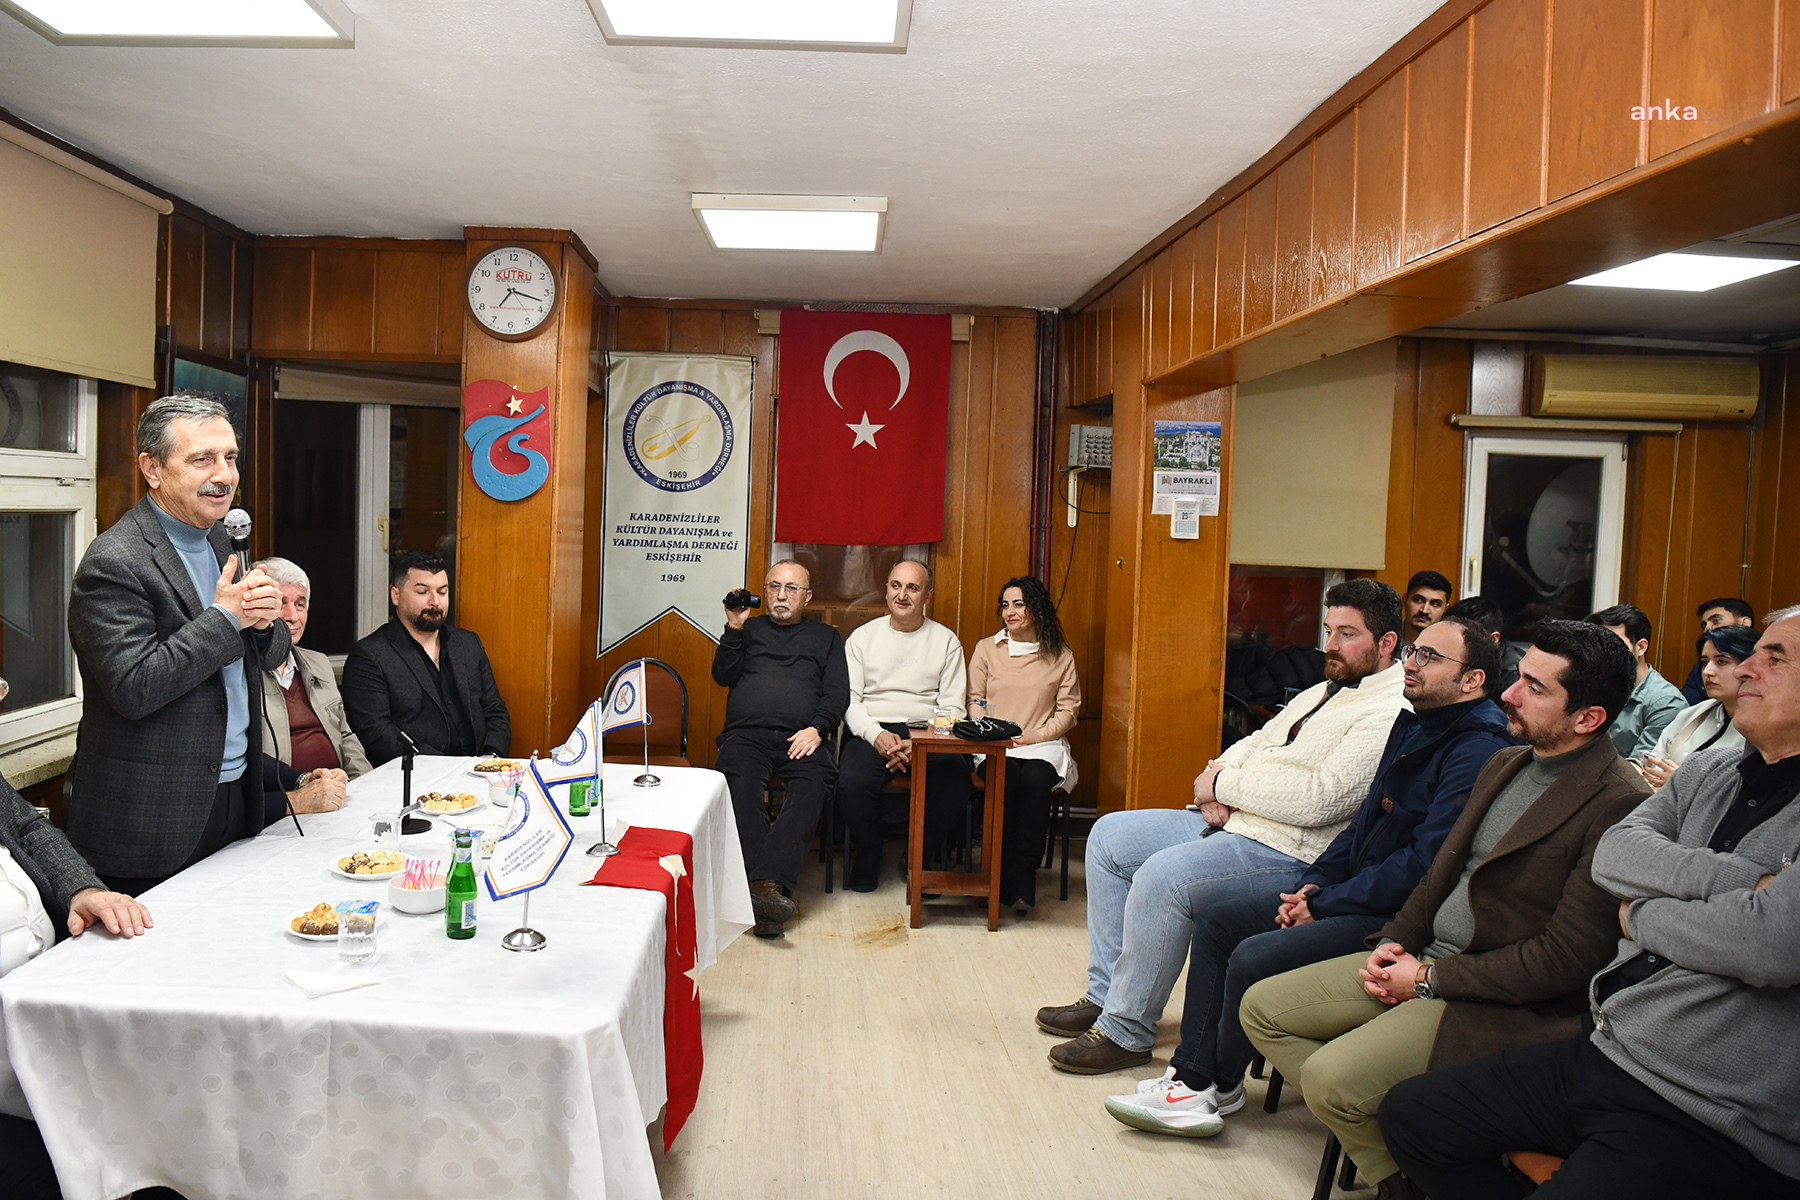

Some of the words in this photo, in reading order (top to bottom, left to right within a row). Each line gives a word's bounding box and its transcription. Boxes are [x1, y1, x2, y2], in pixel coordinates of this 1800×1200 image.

[509, 253, 519, 261] 12
[494, 258, 501, 266] 11
[481, 269, 491, 278] 10
[496, 270, 532, 280] KUTRU
[539, 272, 546, 280] 2
[543, 289, 550, 297] 3
[478, 303, 485, 311] 8
[507, 321, 514, 329] 6
[524, 317, 531, 325] 5
[633, 390, 658, 415] KÜLTÜR
[657, 384, 698, 395] DAYANIŞMA
[699, 389, 706, 397] &
[705, 393, 732, 441] YARDIMLAŞMA
[668, 470, 688, 479] 1969
[655, 478, 702, 491] ESKİŞEHİR
[1173, 477, 1213, 485] BAYRAKLI
[629, 512, 721, 524] KARADENİZLİLER
[1181, 512, 1189, 520] 23
[615, 524, 657, 535] KÜLTÜR
[658, 526, 720, 538] DAYANIŞMA
[612, 538, 689, 550] YARDIMLAŞMA
[691, 540, 739, 551] DERNEĞİ
[645, 552, 702, 563] ESKİŞEHİR
[660, 574, 686, 583] 1969
